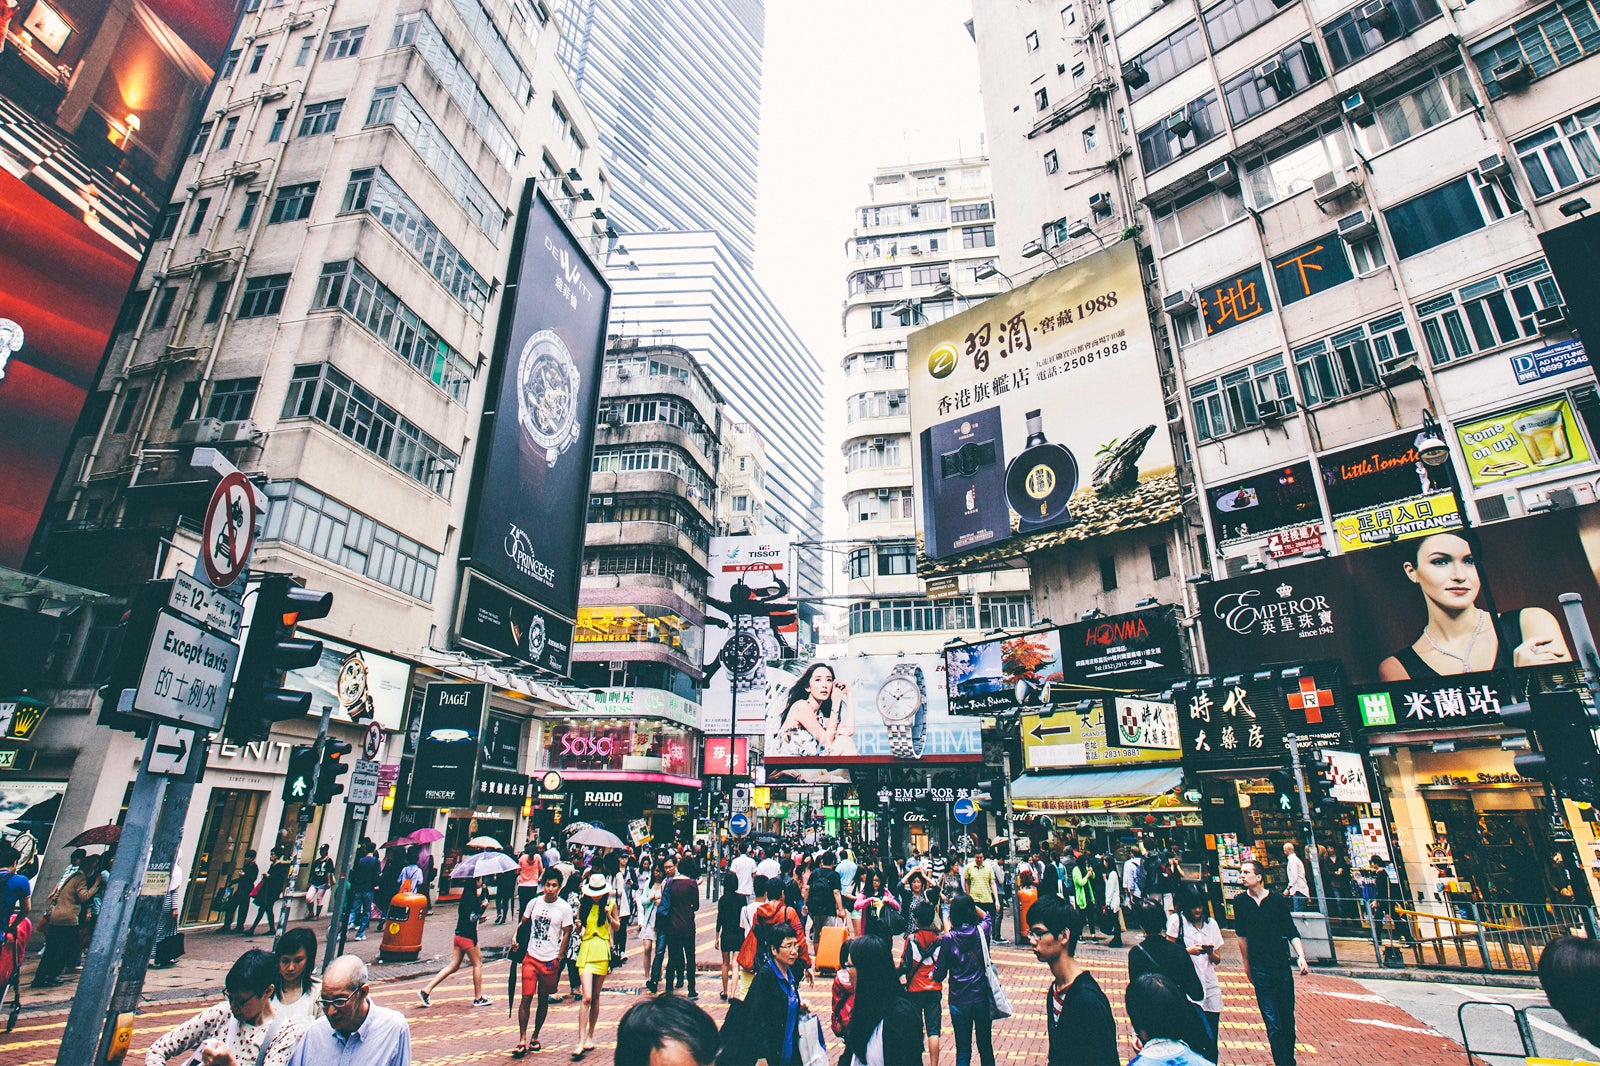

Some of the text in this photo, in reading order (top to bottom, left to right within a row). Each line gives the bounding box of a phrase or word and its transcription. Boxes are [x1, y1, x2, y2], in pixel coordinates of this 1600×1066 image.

[1076, 291, 1118, 320] 1988
[1552, 349, 1586, 363] HOTLINE
[1564, 355, 1589, 367] 2348
[1463, 422, 1506, 446] Come
[1472, 432, 1518, 460] on up!
[1341, 460, 1373, 480] Little
[1357, 500, 1434, 531] 正門入口
[1360, 512, 1460, 544] MAIN ENTRANCE
[748, 550, 780, 558] TISSOT
[178, 578, 192, 592] noon
[228, 608, 240, 630] 12
[1214, 590, 1330, 634] EMPEROR
[206, 612, 227, 628] midnight
[1086, 618, 1149, 646] HONMA
[1260, 610, 1333, 636] 英皇珠寶
[1298, 626, 1334, 638] since 1942
[163, 630, 228, 673] Except taxis
[154, 666, 218, 713] 的士例外
[439, 691, 471, 706] PIAGET
[1189, 686, 1256, 722] 時代
[1404, 685, 1500, 720] 米蘭站
[1141, 704, 1166, 728] 時代
[930, 728, 982, 753] TIME
[1194, 724, 1264, 752] 大藥房
[1104, 750, 1121, 759] 2831
[1123, 750, 1140, 758] 9881
[584, 792, 623, 802] RADO
[658, 794, 672, 804] RADO
